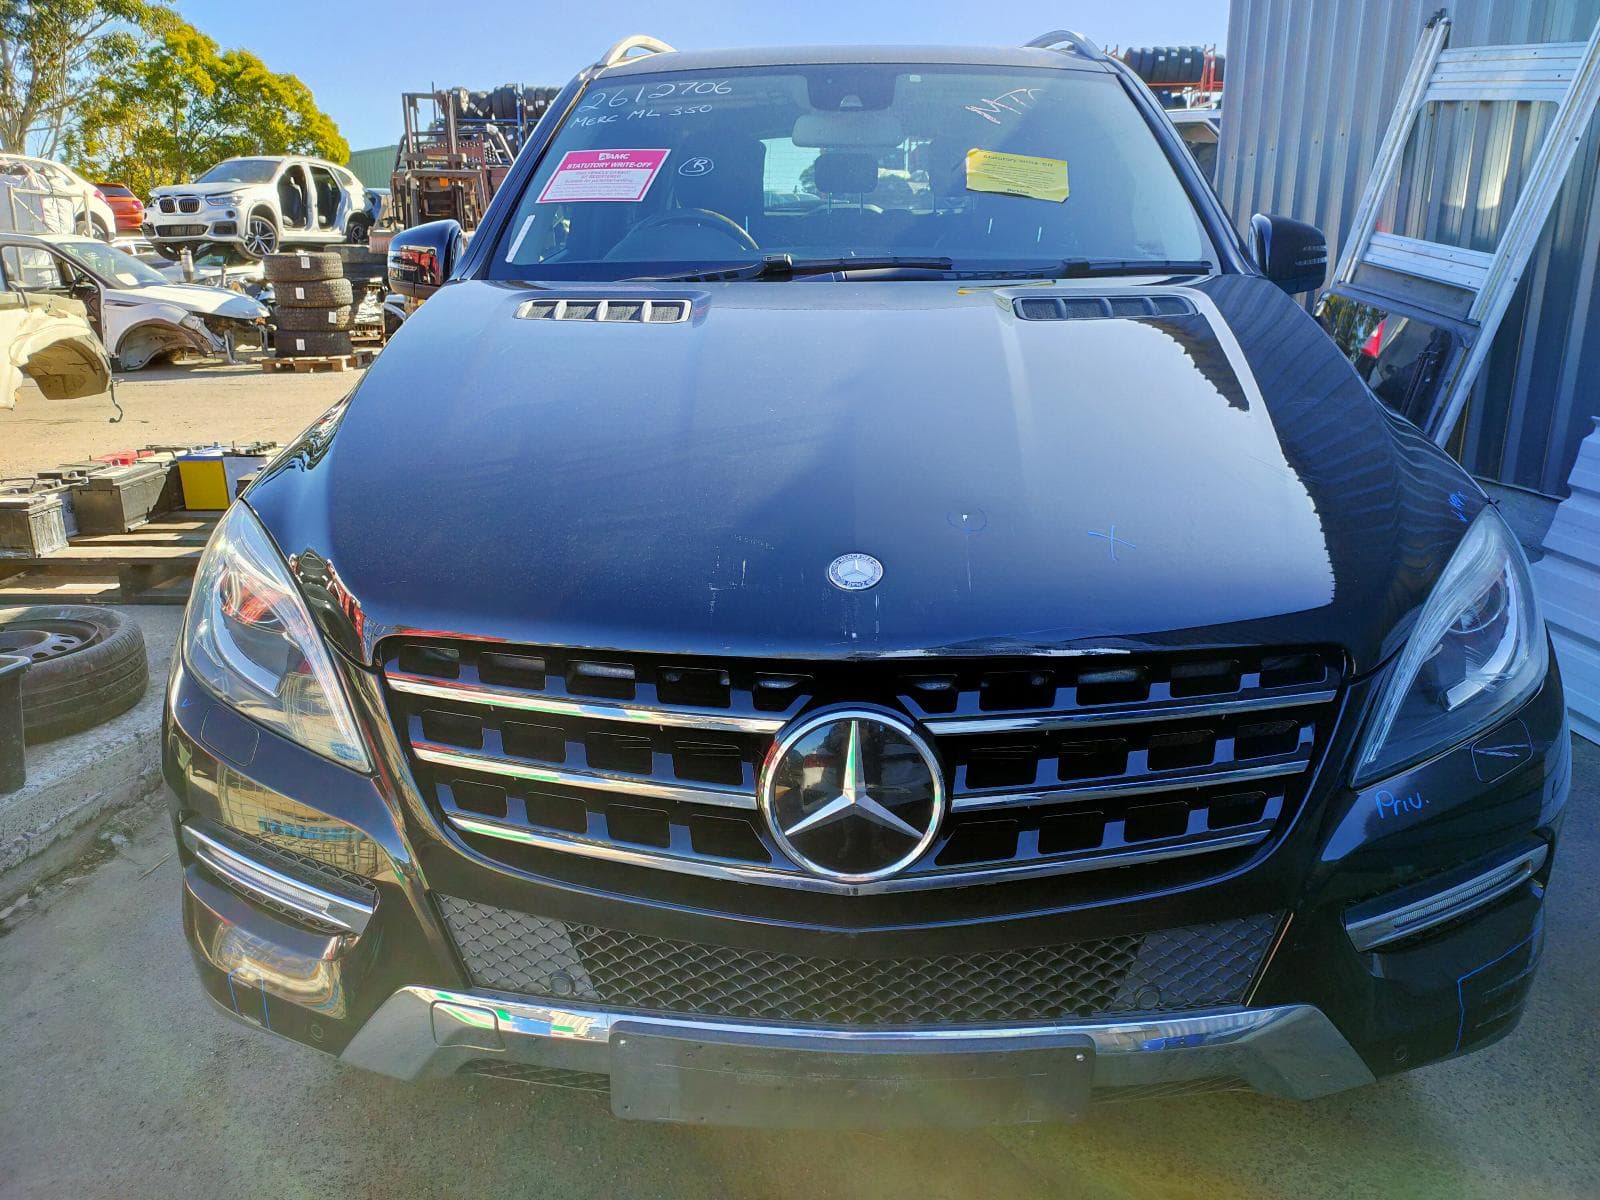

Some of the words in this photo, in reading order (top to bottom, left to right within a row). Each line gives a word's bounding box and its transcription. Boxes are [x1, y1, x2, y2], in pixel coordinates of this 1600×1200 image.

[577, 81, 732, 113] 2612706
[570, 115, 620, 129] MERC
[627, 108, 660, 120] ML
[669, 104, 713, 117] 350
[566, 161, 610, 170] STATUTORY
[610, 161, 653, 169] WRITE-OFF
